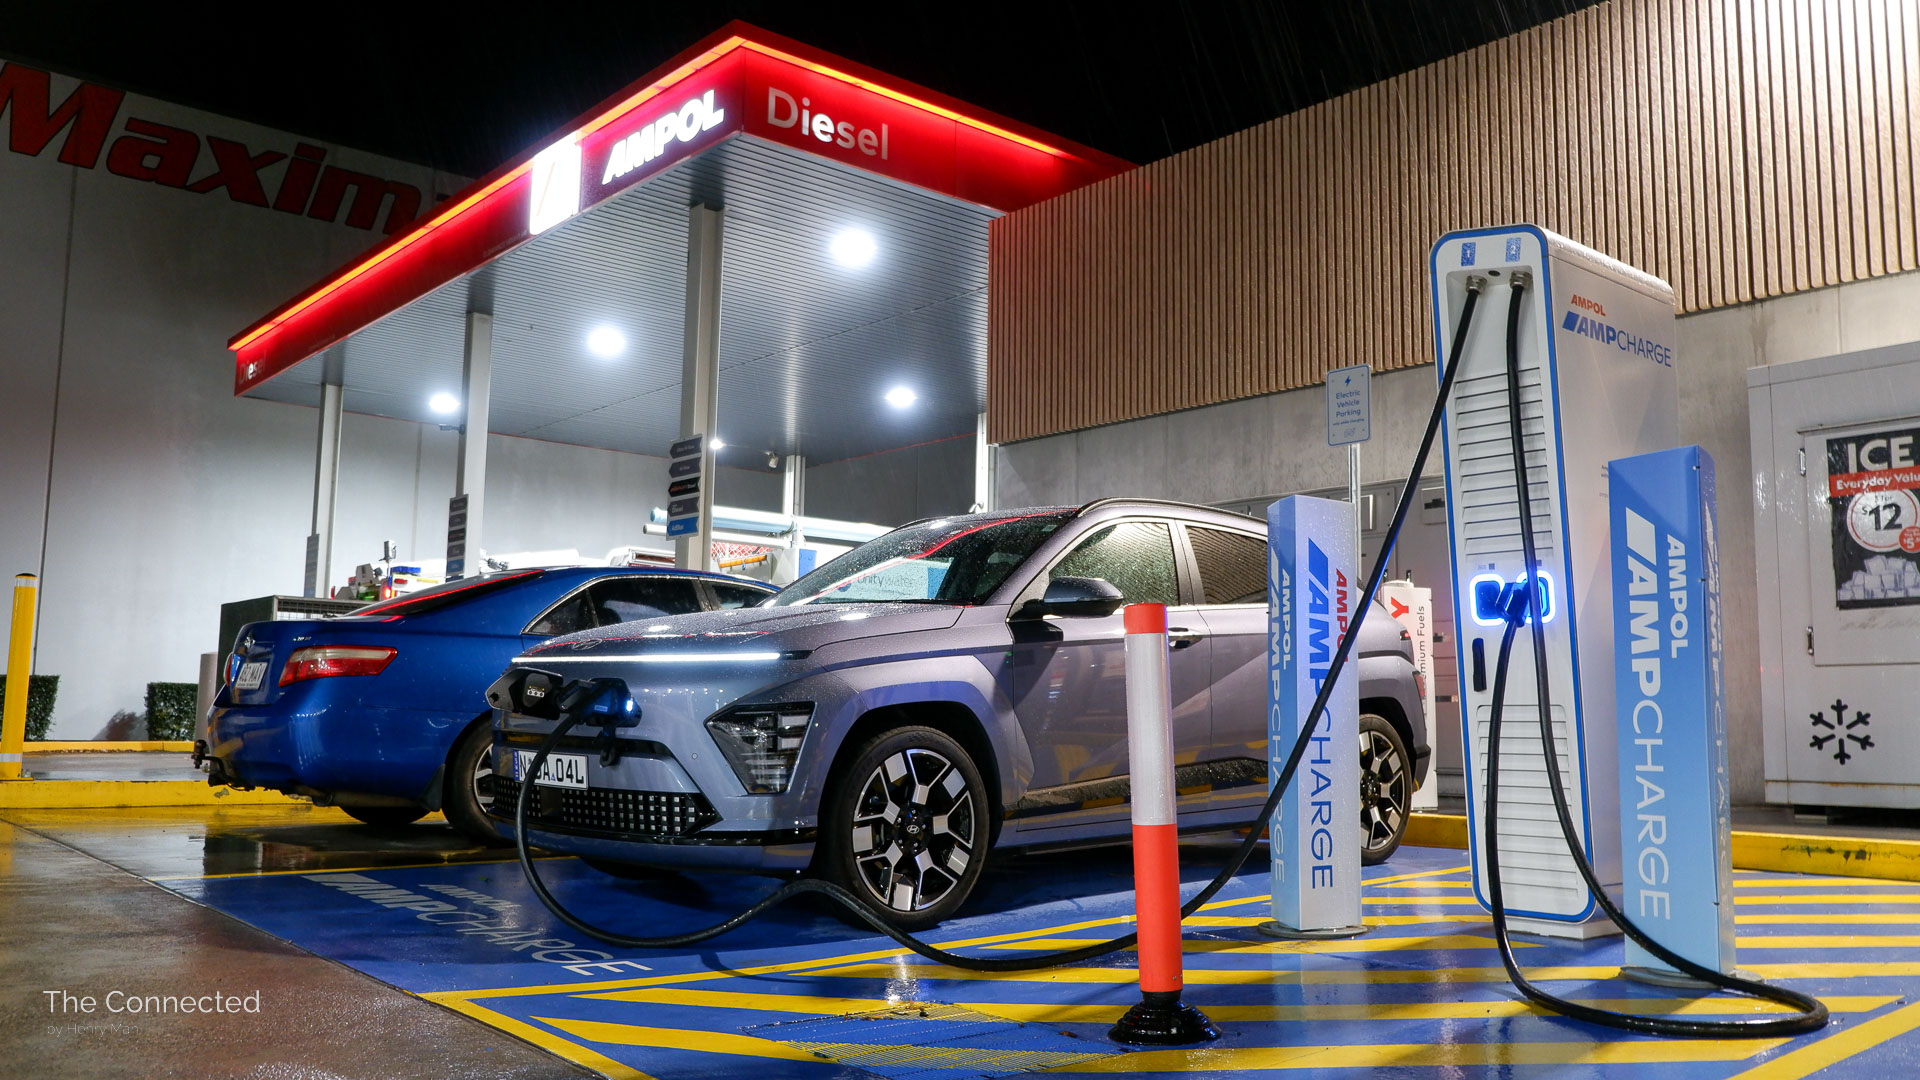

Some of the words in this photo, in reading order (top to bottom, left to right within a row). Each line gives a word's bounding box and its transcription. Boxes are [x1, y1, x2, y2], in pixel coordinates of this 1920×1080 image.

[602, 89, 726, 186] AMPOL
[766, 86, 889, 161] Diesel
[1570, 294, 1606, 317] AMPOL
[1576, 316, 1672, 368] AMPCHARGE
[1336, 390, 1361, 400] Electric
[1336, 399, 1360, 409] Vehicle
[1336, 409, 1361, 418] Parking
[1847, 435, 1915, 474] ICE
[1836, 476, 1892, 490] Everyday
[1336, 568, 1349, 663] AMPO
[1667, 533, 1689, 659] AMPOL
[1282, 568, 1292, 671] AMPOL
[1416, 606, 1425, 636] Fuels
[1626, 554, 1672, 921] AMPCHARGE
[418, 884, 522, 912] AMPOL
[320, 881, 653, 976] AMPCHARGE
